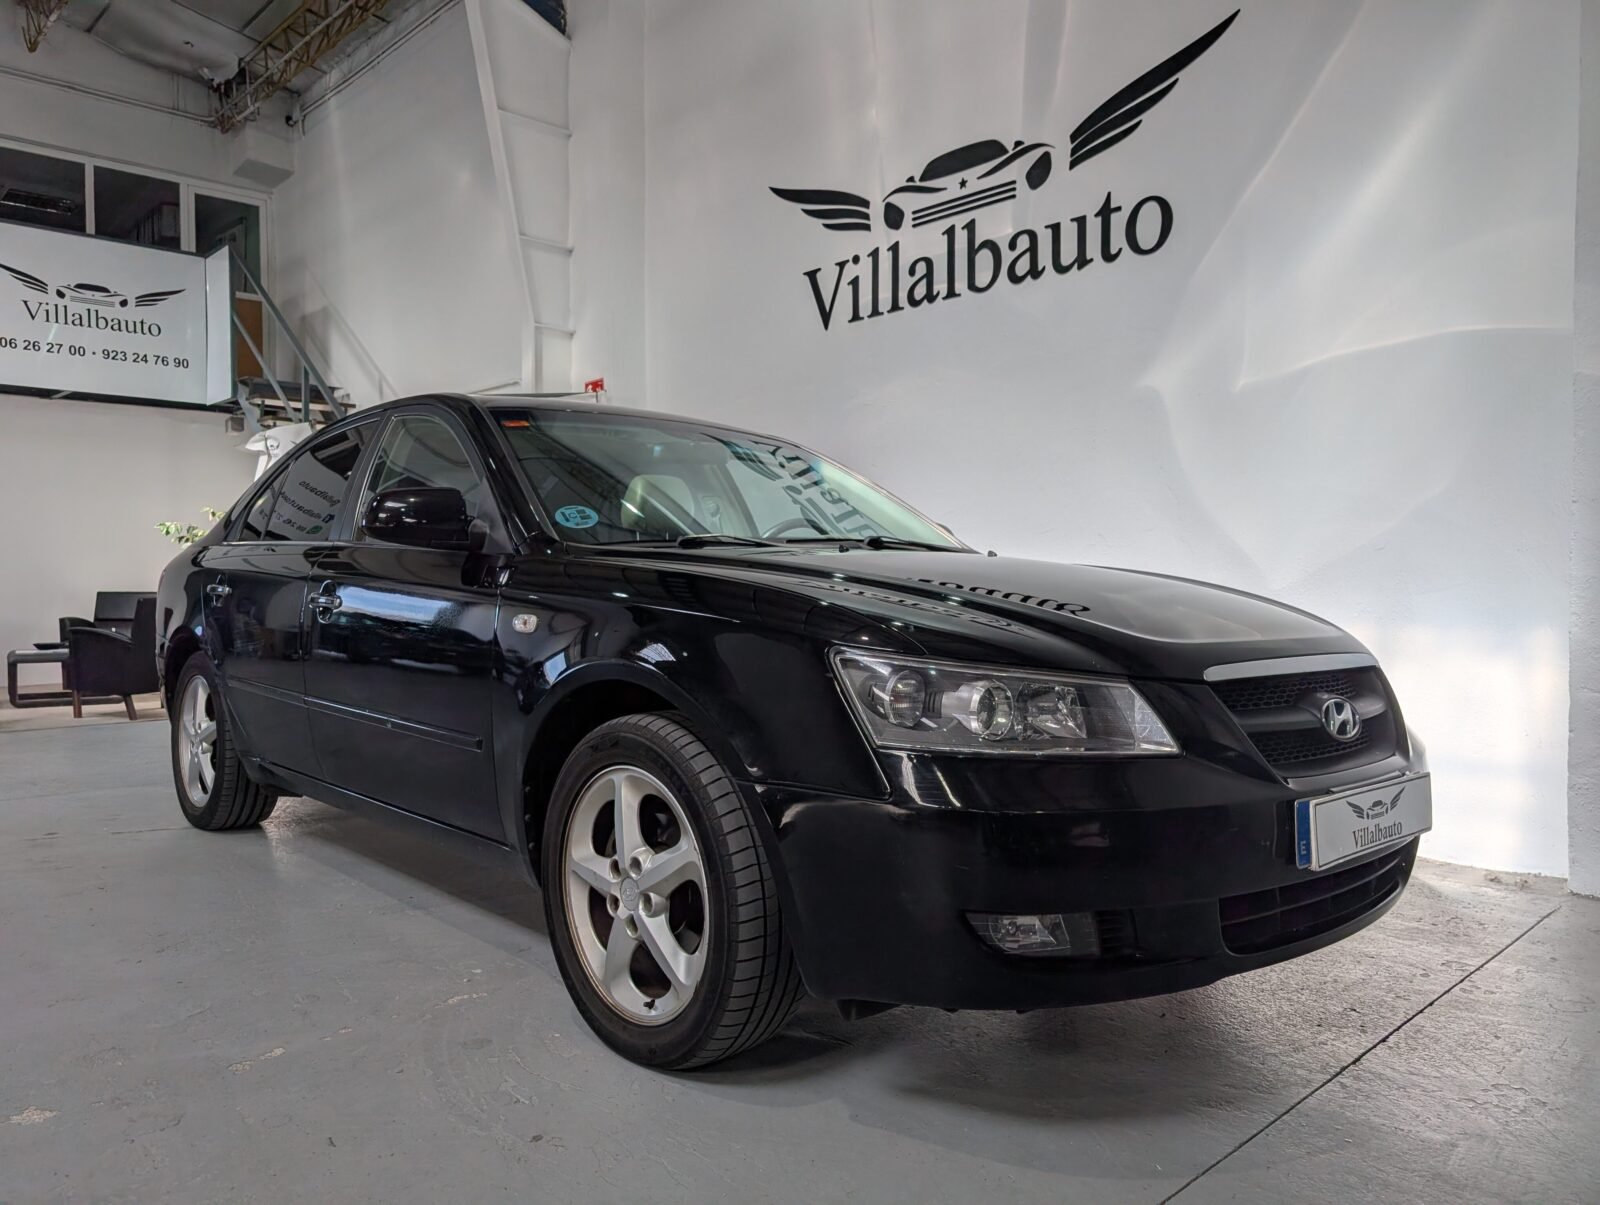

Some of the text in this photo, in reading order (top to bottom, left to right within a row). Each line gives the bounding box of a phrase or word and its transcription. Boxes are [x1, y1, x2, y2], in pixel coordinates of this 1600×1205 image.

[802, 191, 1174, 331] Villalbauto
[21, 299, 162, 337] Villalbauto
[0, 336, 190, 369] 06 26 27 00 923 24 76 90
[1300, 840, 1307, 855] E
[1352, 820, 1403, 849] Villalbauto
